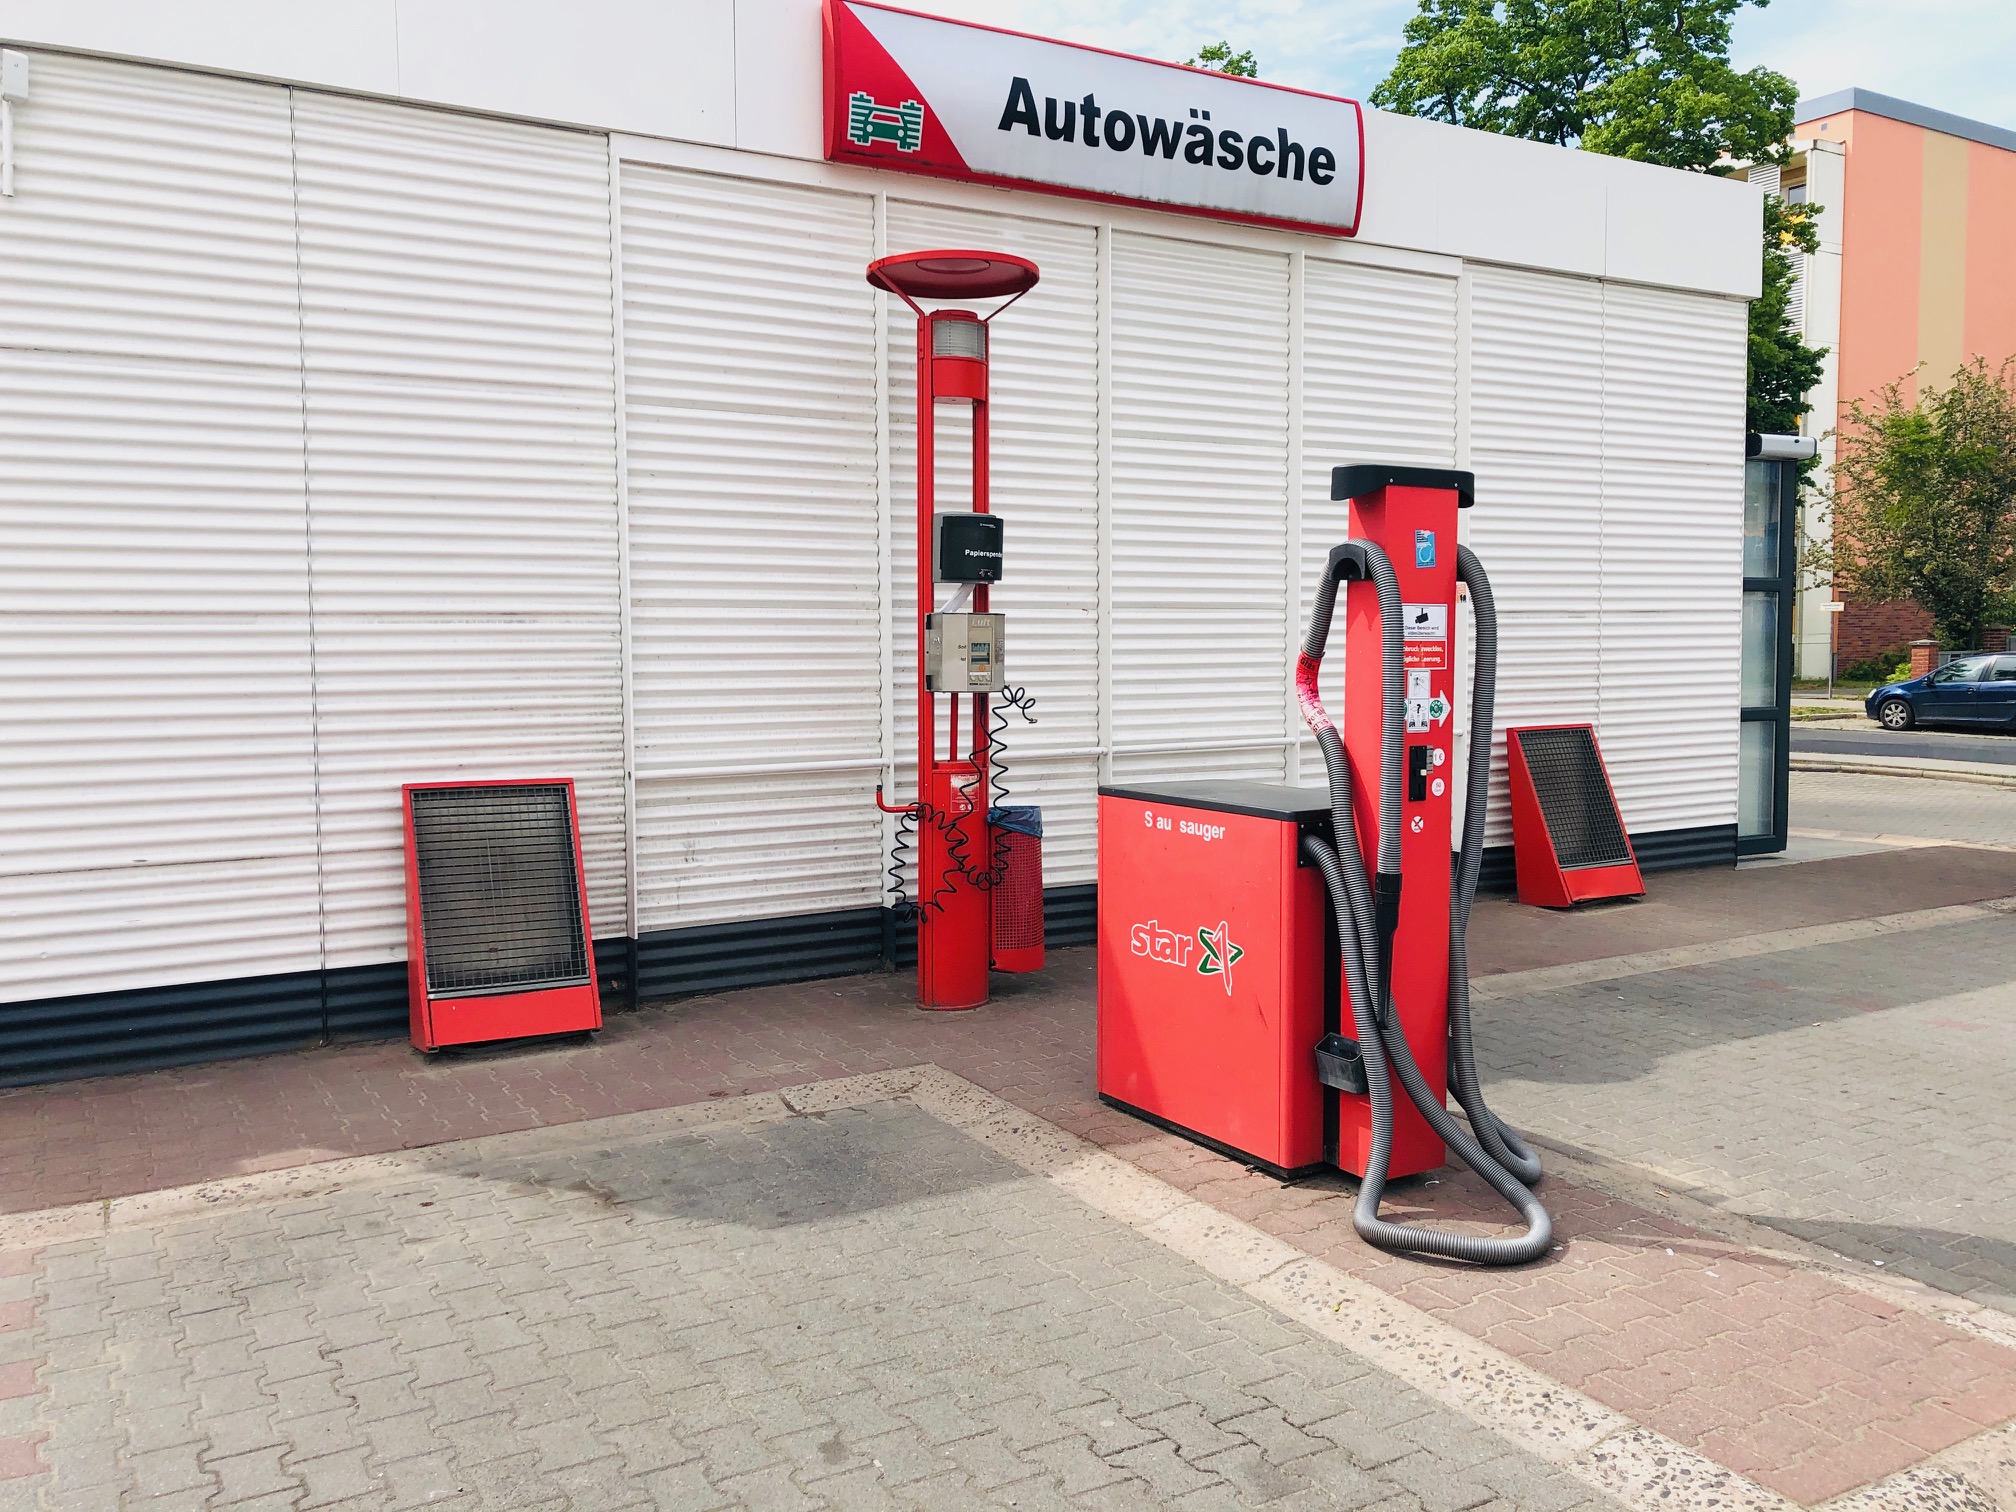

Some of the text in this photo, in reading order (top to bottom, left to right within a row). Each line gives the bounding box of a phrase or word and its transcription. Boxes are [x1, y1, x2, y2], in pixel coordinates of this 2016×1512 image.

[998, 76, 1336, 186] Autowäsche
[971, 618, 991, 627] Luft
[1180, 820, 1225, 841] sauger
[1131, 920, 1193, 967] star
